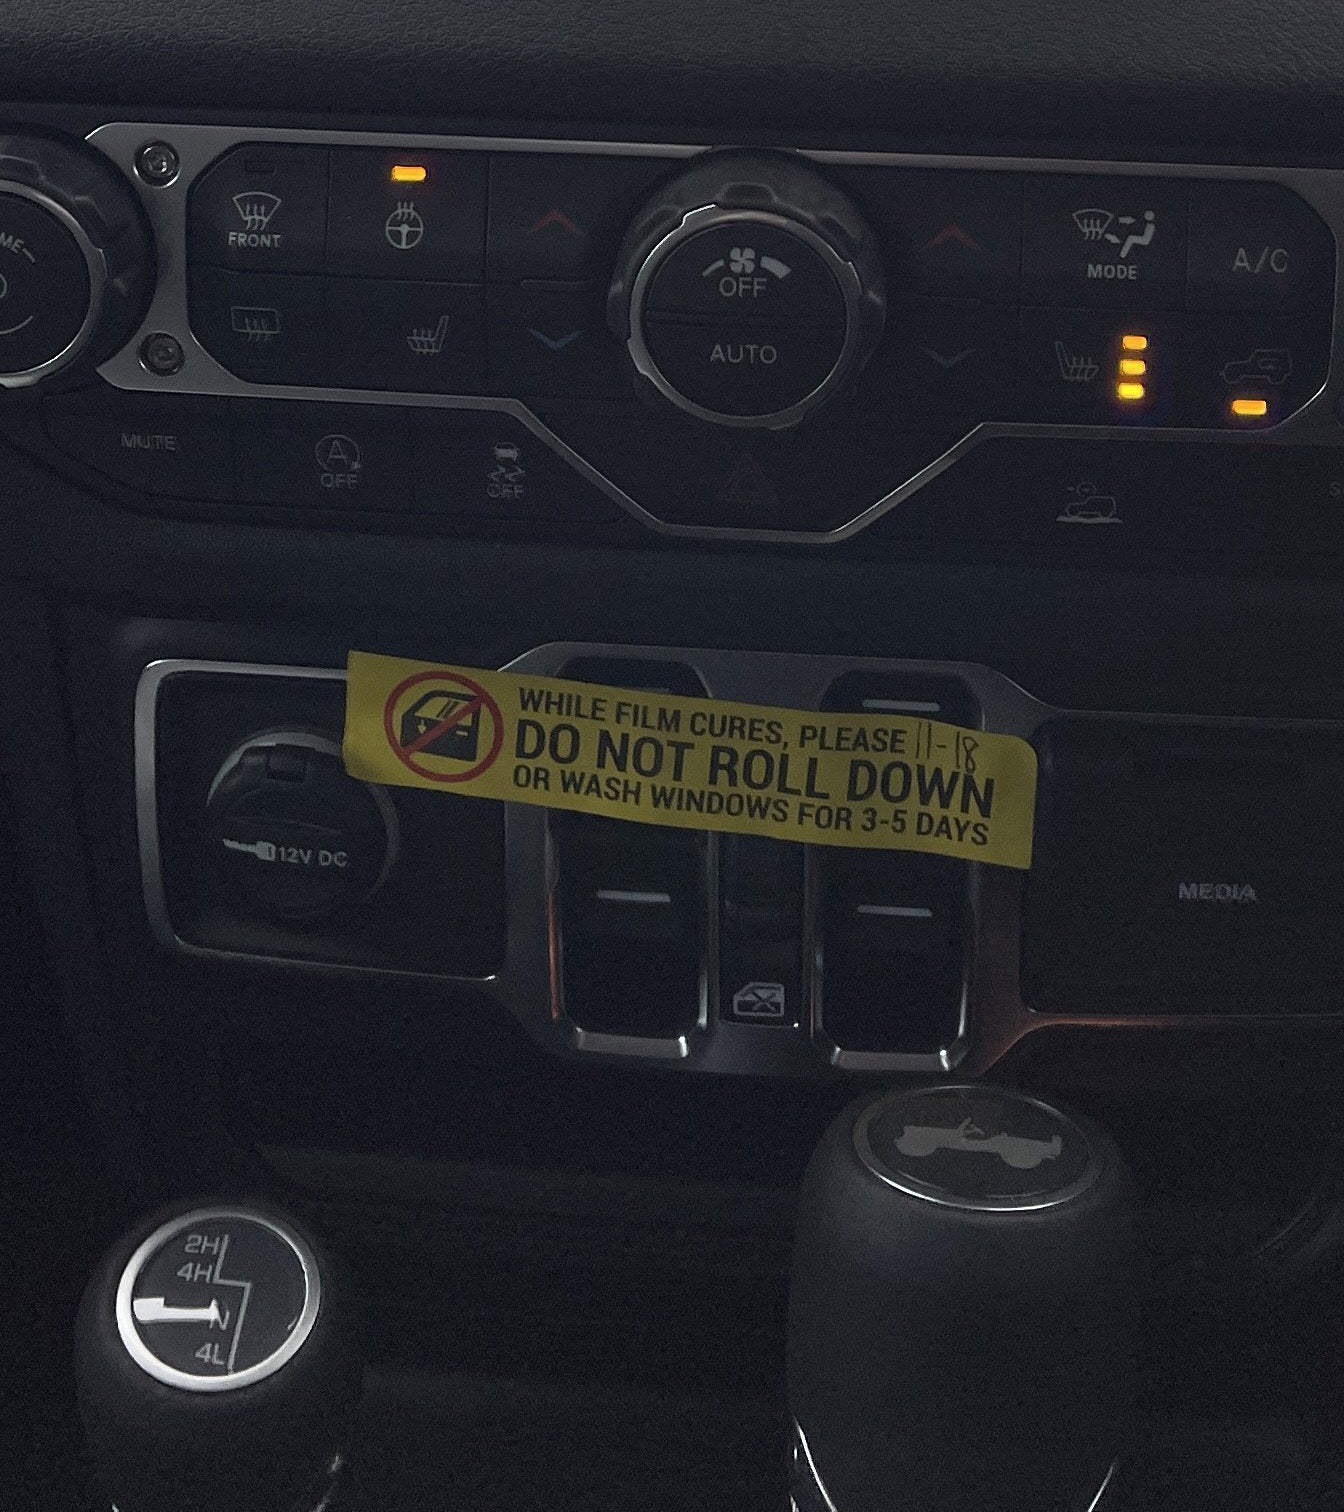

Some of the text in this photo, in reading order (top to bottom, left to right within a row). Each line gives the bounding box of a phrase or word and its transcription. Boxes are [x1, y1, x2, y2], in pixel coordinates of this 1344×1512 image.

[228, 232, 282, 249] FRONT
[1232, 247, 1289, 274] A/C
[1087, 263, 1137, 281] MODE
[718, 278, 768, 297] OFF
[710, 343, 777, 365] AUTO
[121, 432, 177, 451] MUTE
[320, 473, 359, 489] OFF
[518, 688, 908, 755] WHILE FILM CURES, PLEASE
[515, 719, 996, 819] DO NOT ROLL DOWN
[513, 764, 990, 847] OR WASH WINDOWS FOR 3-5 DAYS
[278, 845, 349, 868] 12V DC
[1178, 881, 1257, 903] MEDIA
[184, 1234, 220, 1255] 2H
[176, 1262, 213, 1283] 4H
[194, 1342, 225, 1366] 4L
